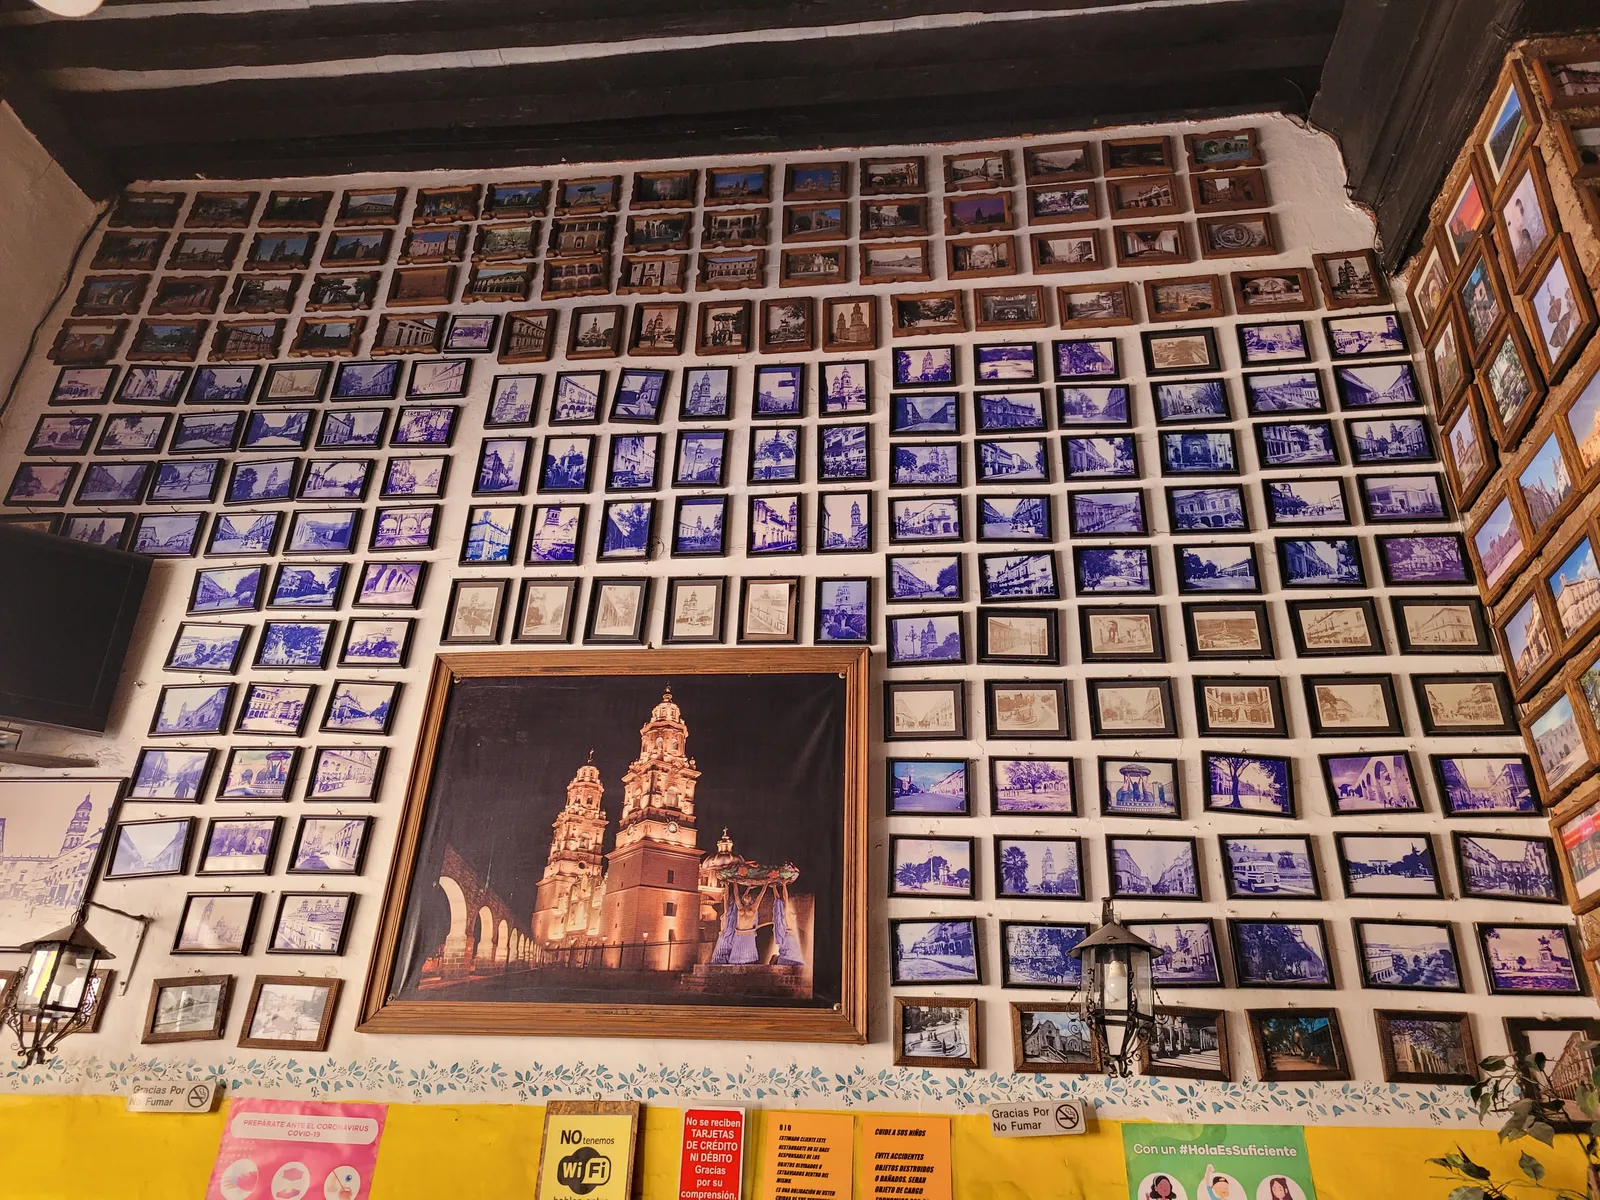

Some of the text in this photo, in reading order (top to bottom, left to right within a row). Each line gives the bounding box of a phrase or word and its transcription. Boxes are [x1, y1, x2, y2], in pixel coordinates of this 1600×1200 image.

[133, 1085, 185, 1094] Gracias Por
[145, 1097, 173, 1106] Fumar
[991, 1107, 1050, 1119] Gracias Por
[286, 1121, 305, 1129] ANTE
[306, 1122, 315, 1130] EL
[316, 1123, 369, 1132] CORONAVIRUS
[686, 1117, 698, 1126] No
[711, 1118, 741, 1128] reciben
[993, 1121, 1042, 1132] No Fumar
[287, 1129, 321, 1138] COVID-19
[560, 1129, 615, 1145] NO tenemos
[691, 1129, 735, 1139] TARJETAS
[874, 1128, 892, 1136] CUIDE
[908, 1129, 927, 1137] NIÑOS
[686, 1140, 738, 1151] DE CRÉDITO
[1133, 1143, 1298, 1157] Con un #HolaEsSuficiente
[690, 1151, 733, 1163] NI DÉBITO
[890, 1152, 925, 1160] ACCIDENTES
[695, 1165, 726, 1175] Gracias
[874, 1164, 935, 1173] OBJETOS DESTRUIDOS
[696, 1179, 723, 1188] por su
[680, 1190, 737, 1200] comprensión.
[874, 1186, 896, 1194] OBJETO
[904, 1187, 924, 1195] CARGO
